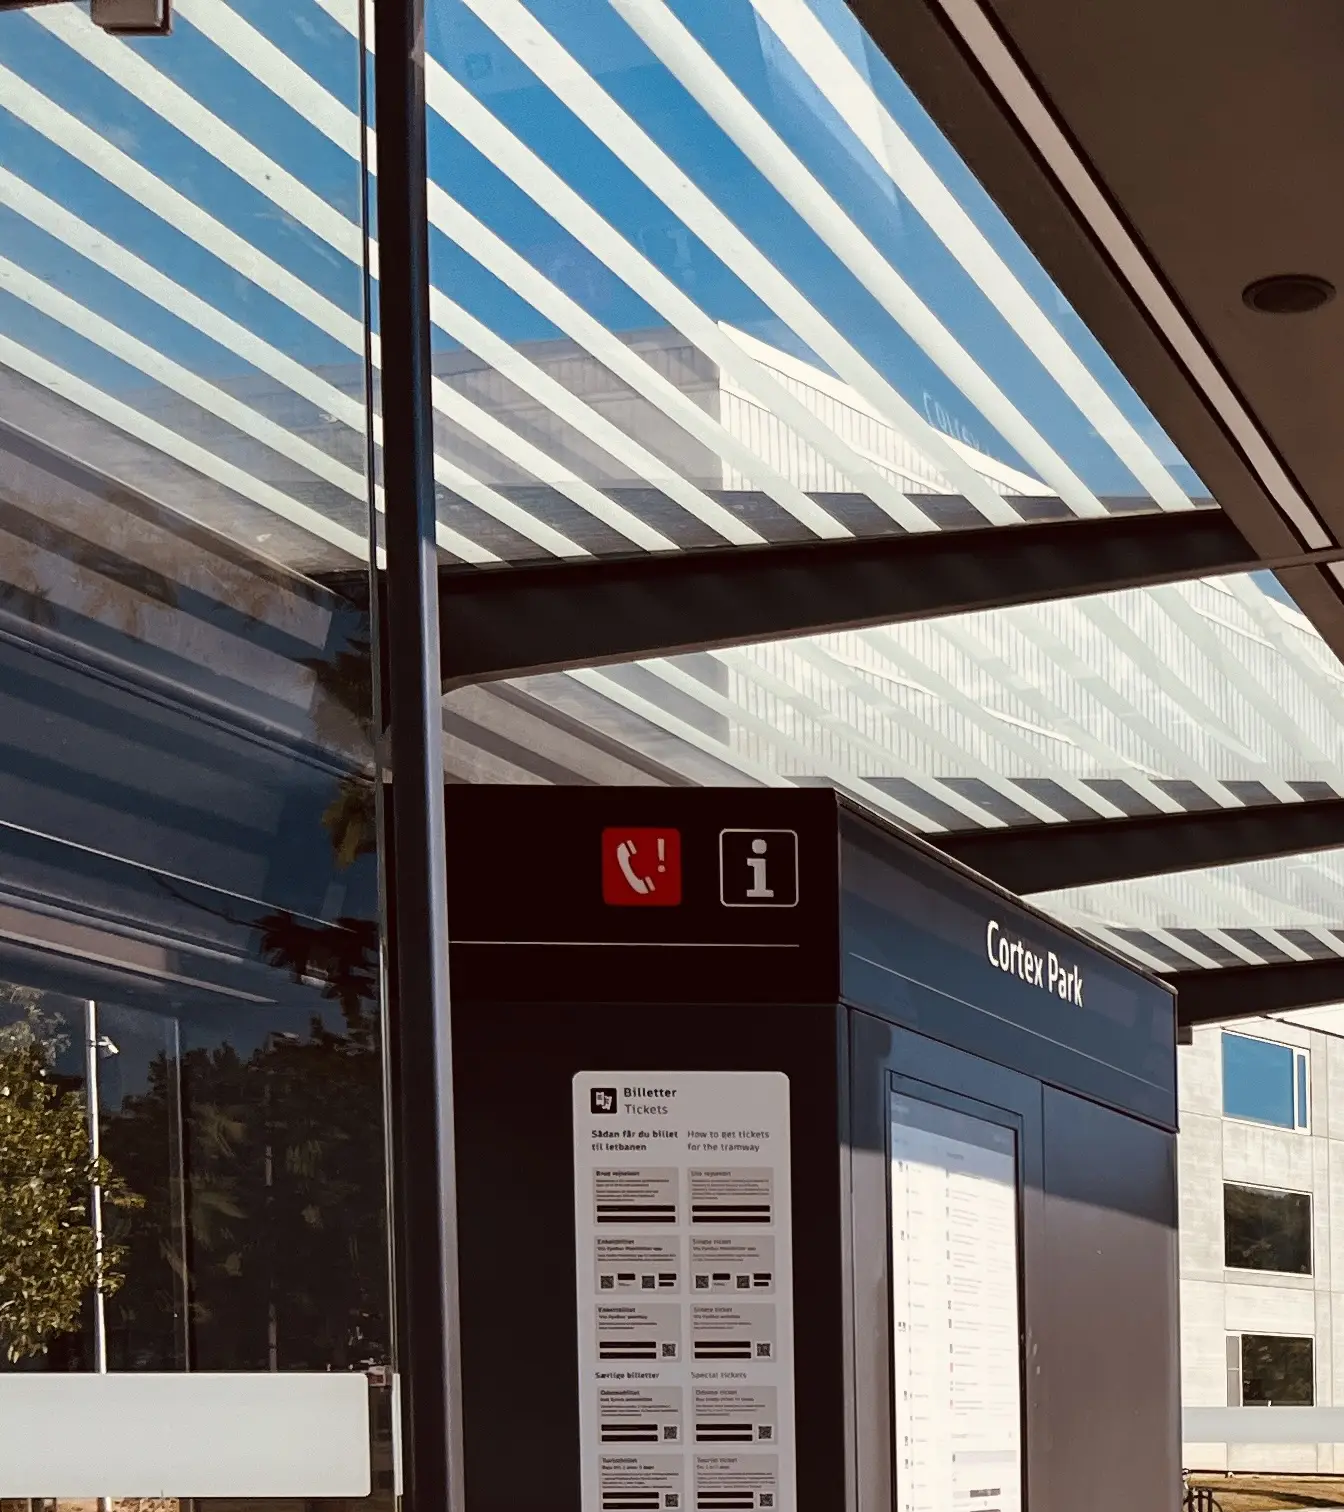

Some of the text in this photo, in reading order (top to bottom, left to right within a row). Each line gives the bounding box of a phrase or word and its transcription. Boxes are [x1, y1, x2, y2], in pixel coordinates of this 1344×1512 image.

[986, 920, 1084, 1008] Cortex Park
[624, 1087, 677, 1098] Billetter
[624, 1104, 669, 1115] Tickets
[638, 1129, 650, 1139] du
[652, 1129, 678, 1139] billet
[687, 1129, 708, 1139] How
[709, 1130, 719, 1139] to
[738, 1129, 770, 1139] tickets
[687, 1142, 701, 1151] for
[703, 1142, 718, 1151] the
